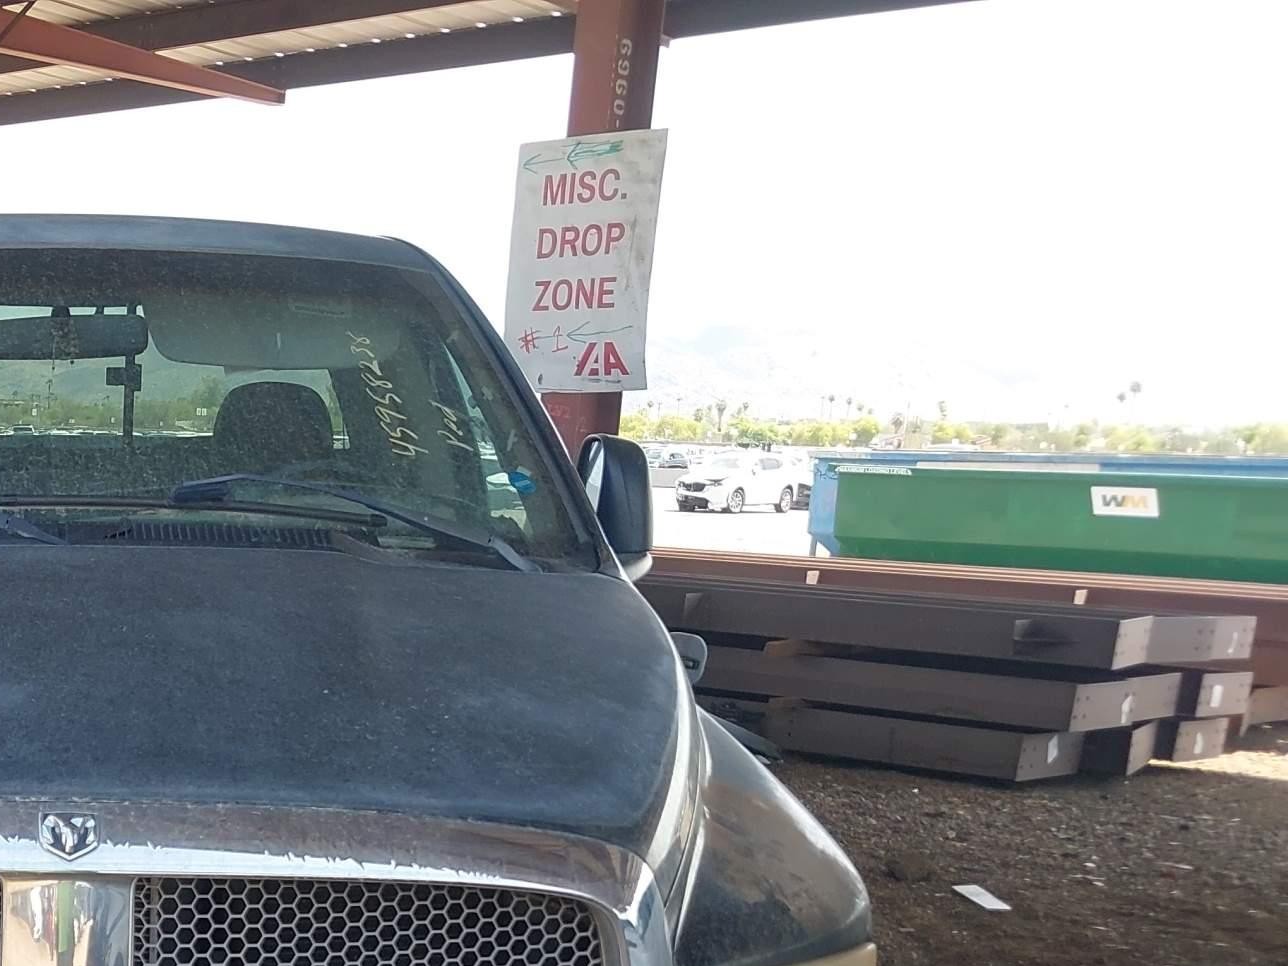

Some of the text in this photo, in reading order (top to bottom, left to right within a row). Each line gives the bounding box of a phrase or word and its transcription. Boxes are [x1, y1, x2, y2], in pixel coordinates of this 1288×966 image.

[542, 169, 627, 206] MISC.
[536, 222, 626, 259] DROP
[532, 277, 617, 311] ZONE
[345, 330, 429, 456] 45958238
[1099, 495, 1148, 509] WM
